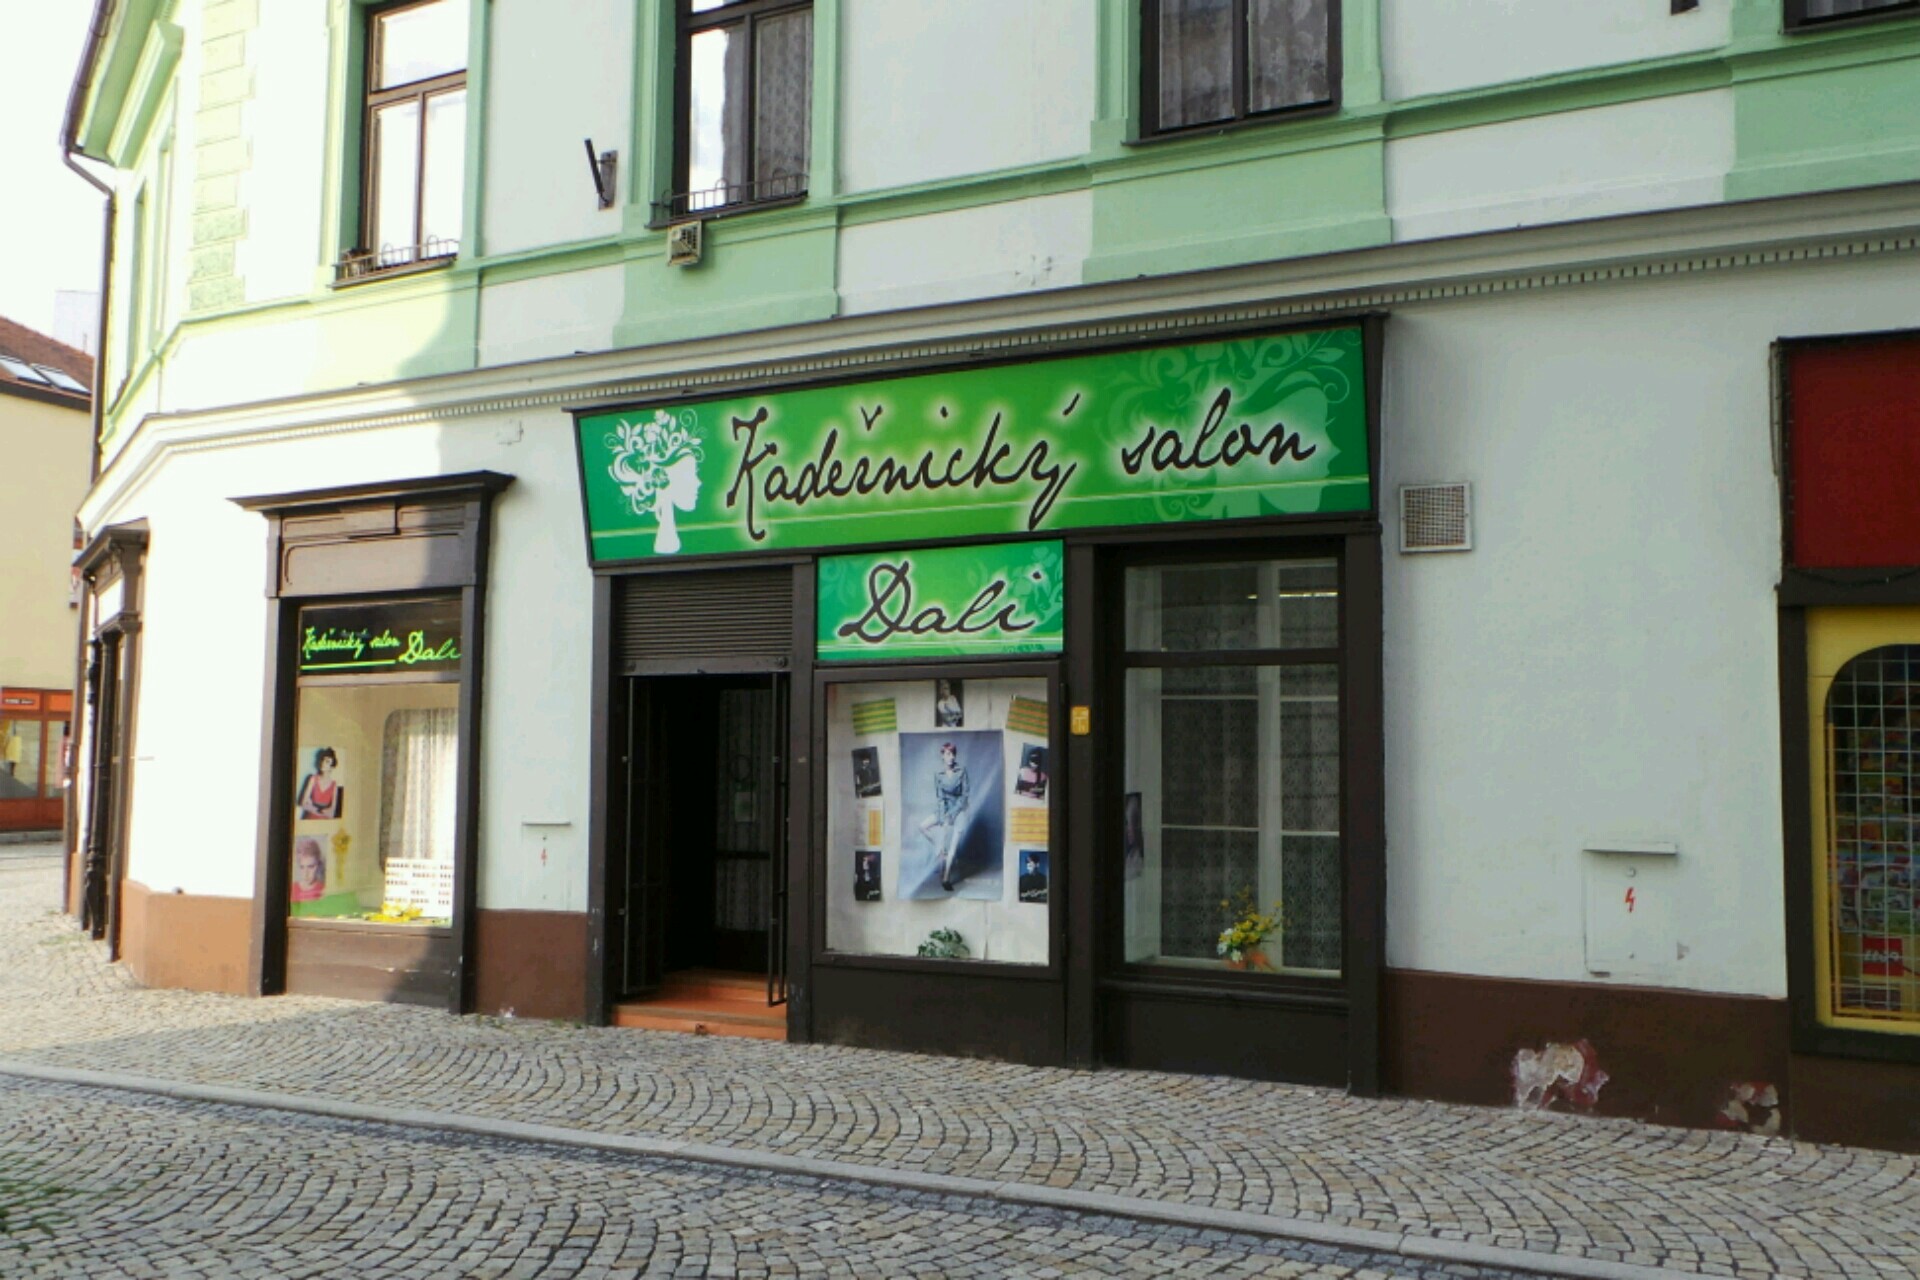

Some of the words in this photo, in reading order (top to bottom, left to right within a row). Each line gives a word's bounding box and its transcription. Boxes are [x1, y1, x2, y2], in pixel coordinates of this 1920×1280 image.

[726, 392, 1078, 541] Kadeřnický
[1121, 387, 1317, 475] salon
[838, 560, 1042, 643] Dali
